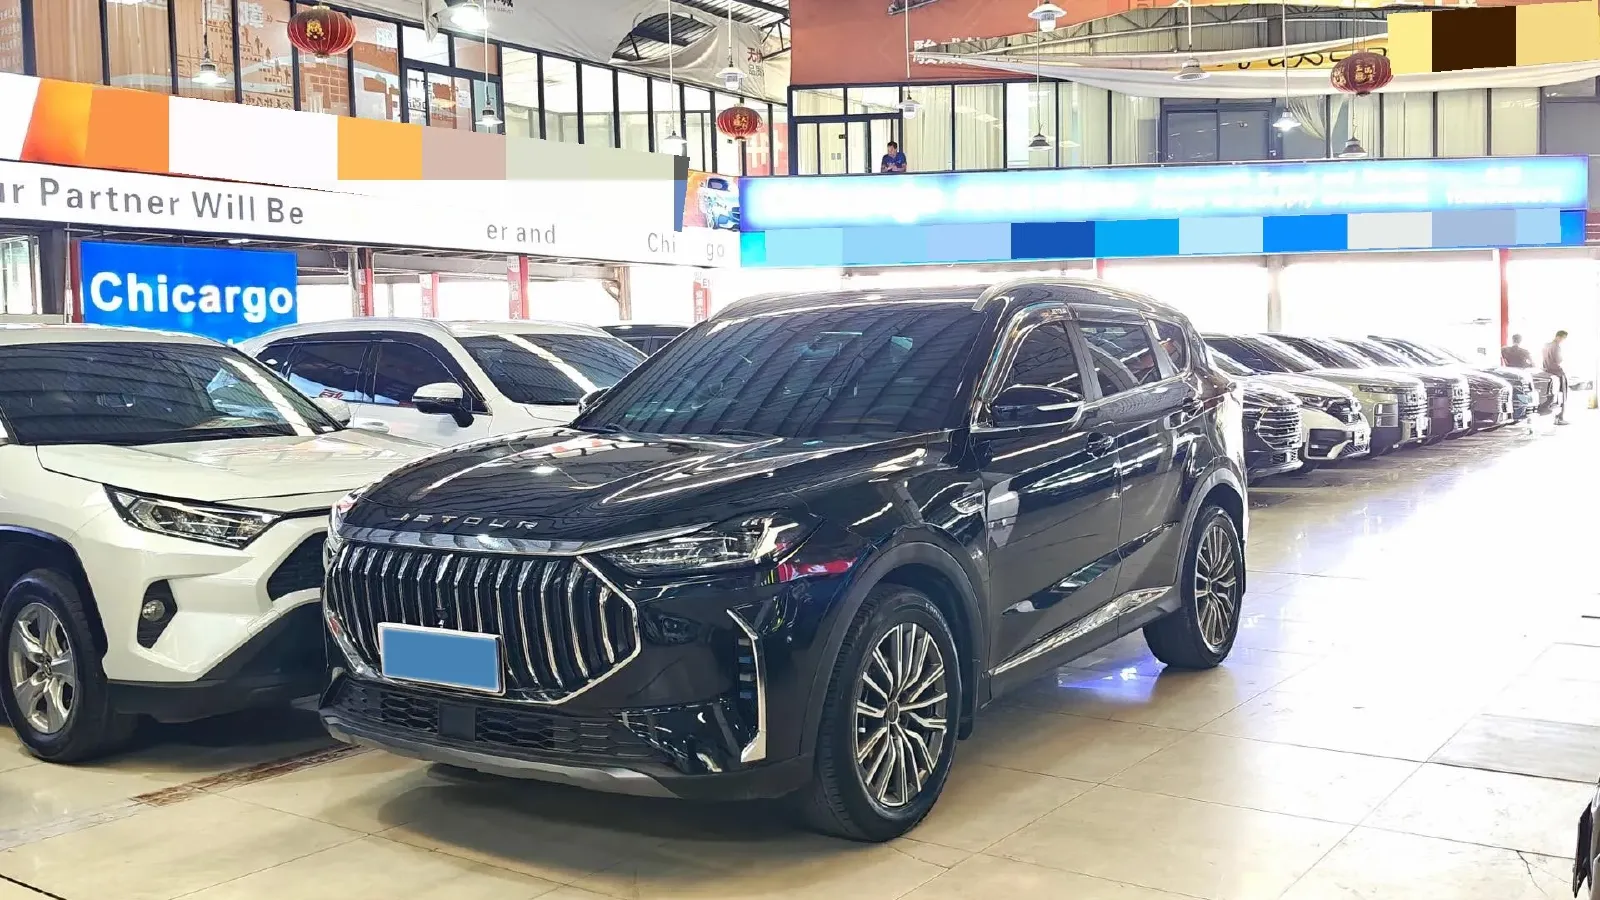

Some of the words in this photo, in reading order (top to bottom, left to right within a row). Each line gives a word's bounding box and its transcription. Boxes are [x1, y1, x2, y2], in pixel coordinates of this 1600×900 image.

[40, 177, 181, 216] Partner
[192, 191, 254, 221] Will
[267, 197, 303, 224] Be
[516, 224, 556, 244] and
[90, 271, 293, 323] Chicargo
[391, 512, 539, 530] JETOUR
